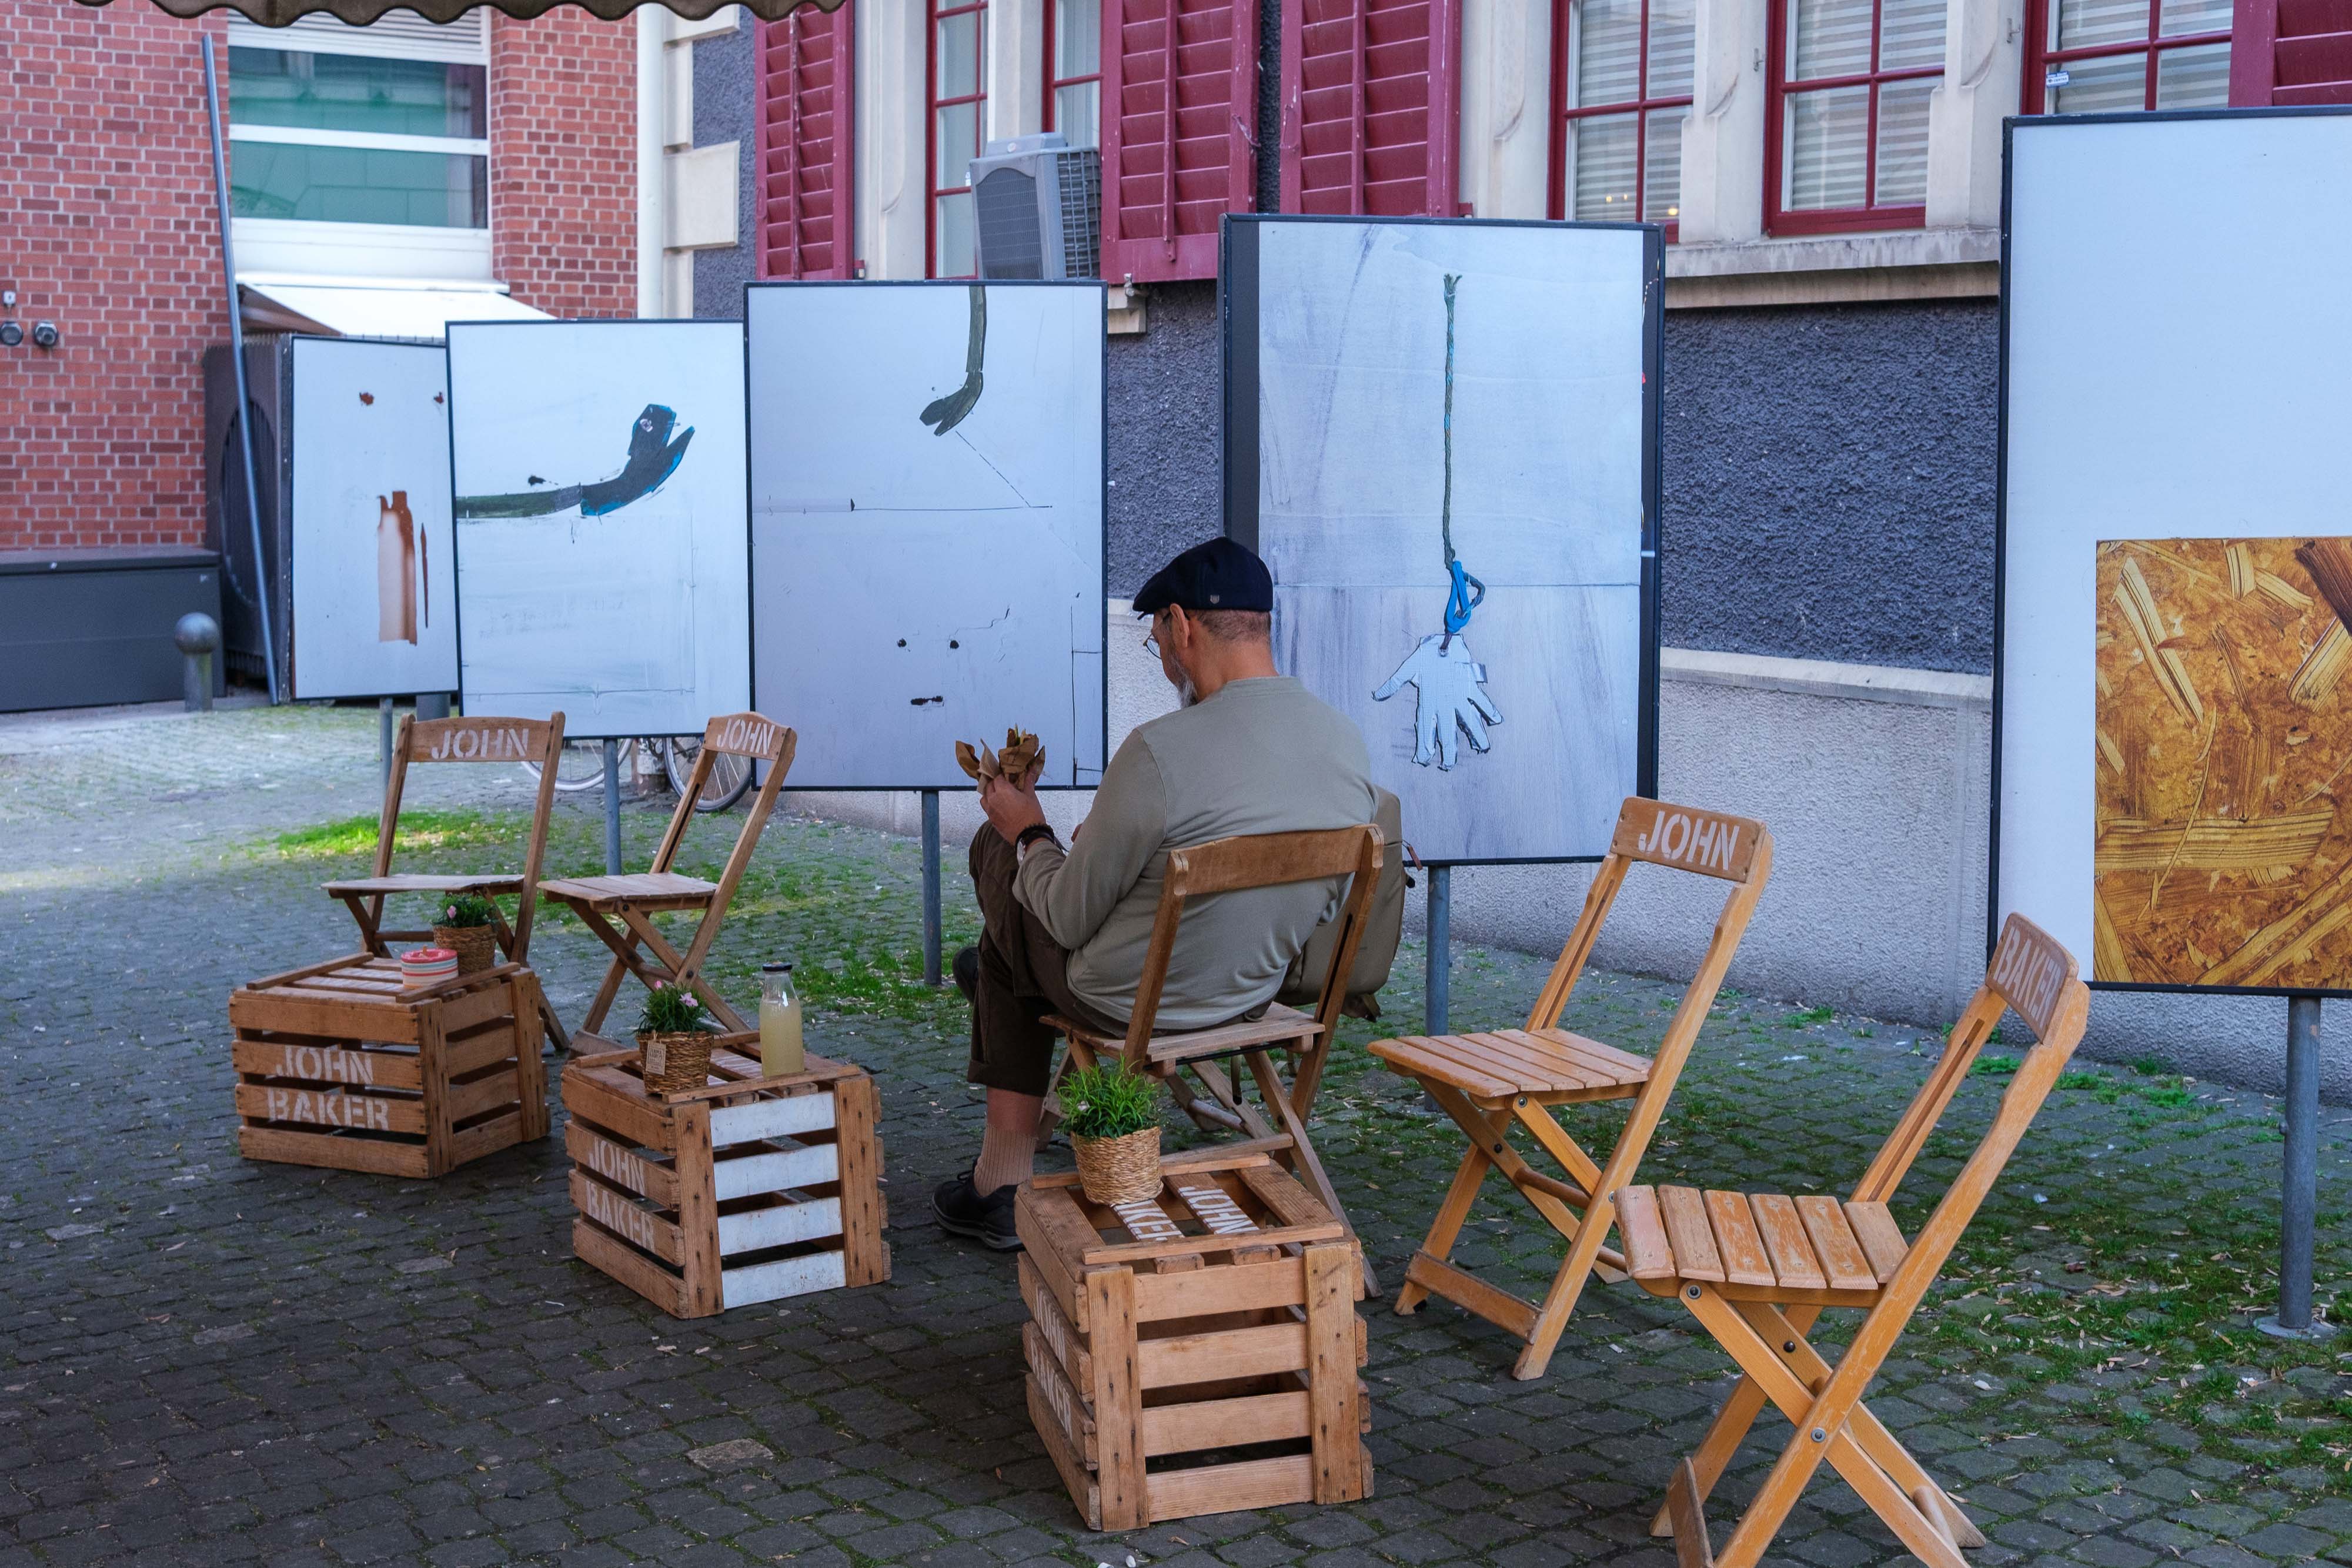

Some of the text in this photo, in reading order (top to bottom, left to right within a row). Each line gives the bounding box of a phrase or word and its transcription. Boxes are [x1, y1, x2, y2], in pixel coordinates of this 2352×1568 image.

[431, 728, 529, 760] JOHN
[716, 718, 775, 755] JOHN
[1638, 811, 1739, 870] JOHN
[1993, 927, 2061, 1028] BAKER
[276, 1044, 373, 1085] JOHN
[267, 1086, 389, 1131] BAKER
[589, 1136, 645, 1196] JOHN
[586, 1180, 656, 1253] BAKER
[1178, 1186, 1259, 1235] JOHN
